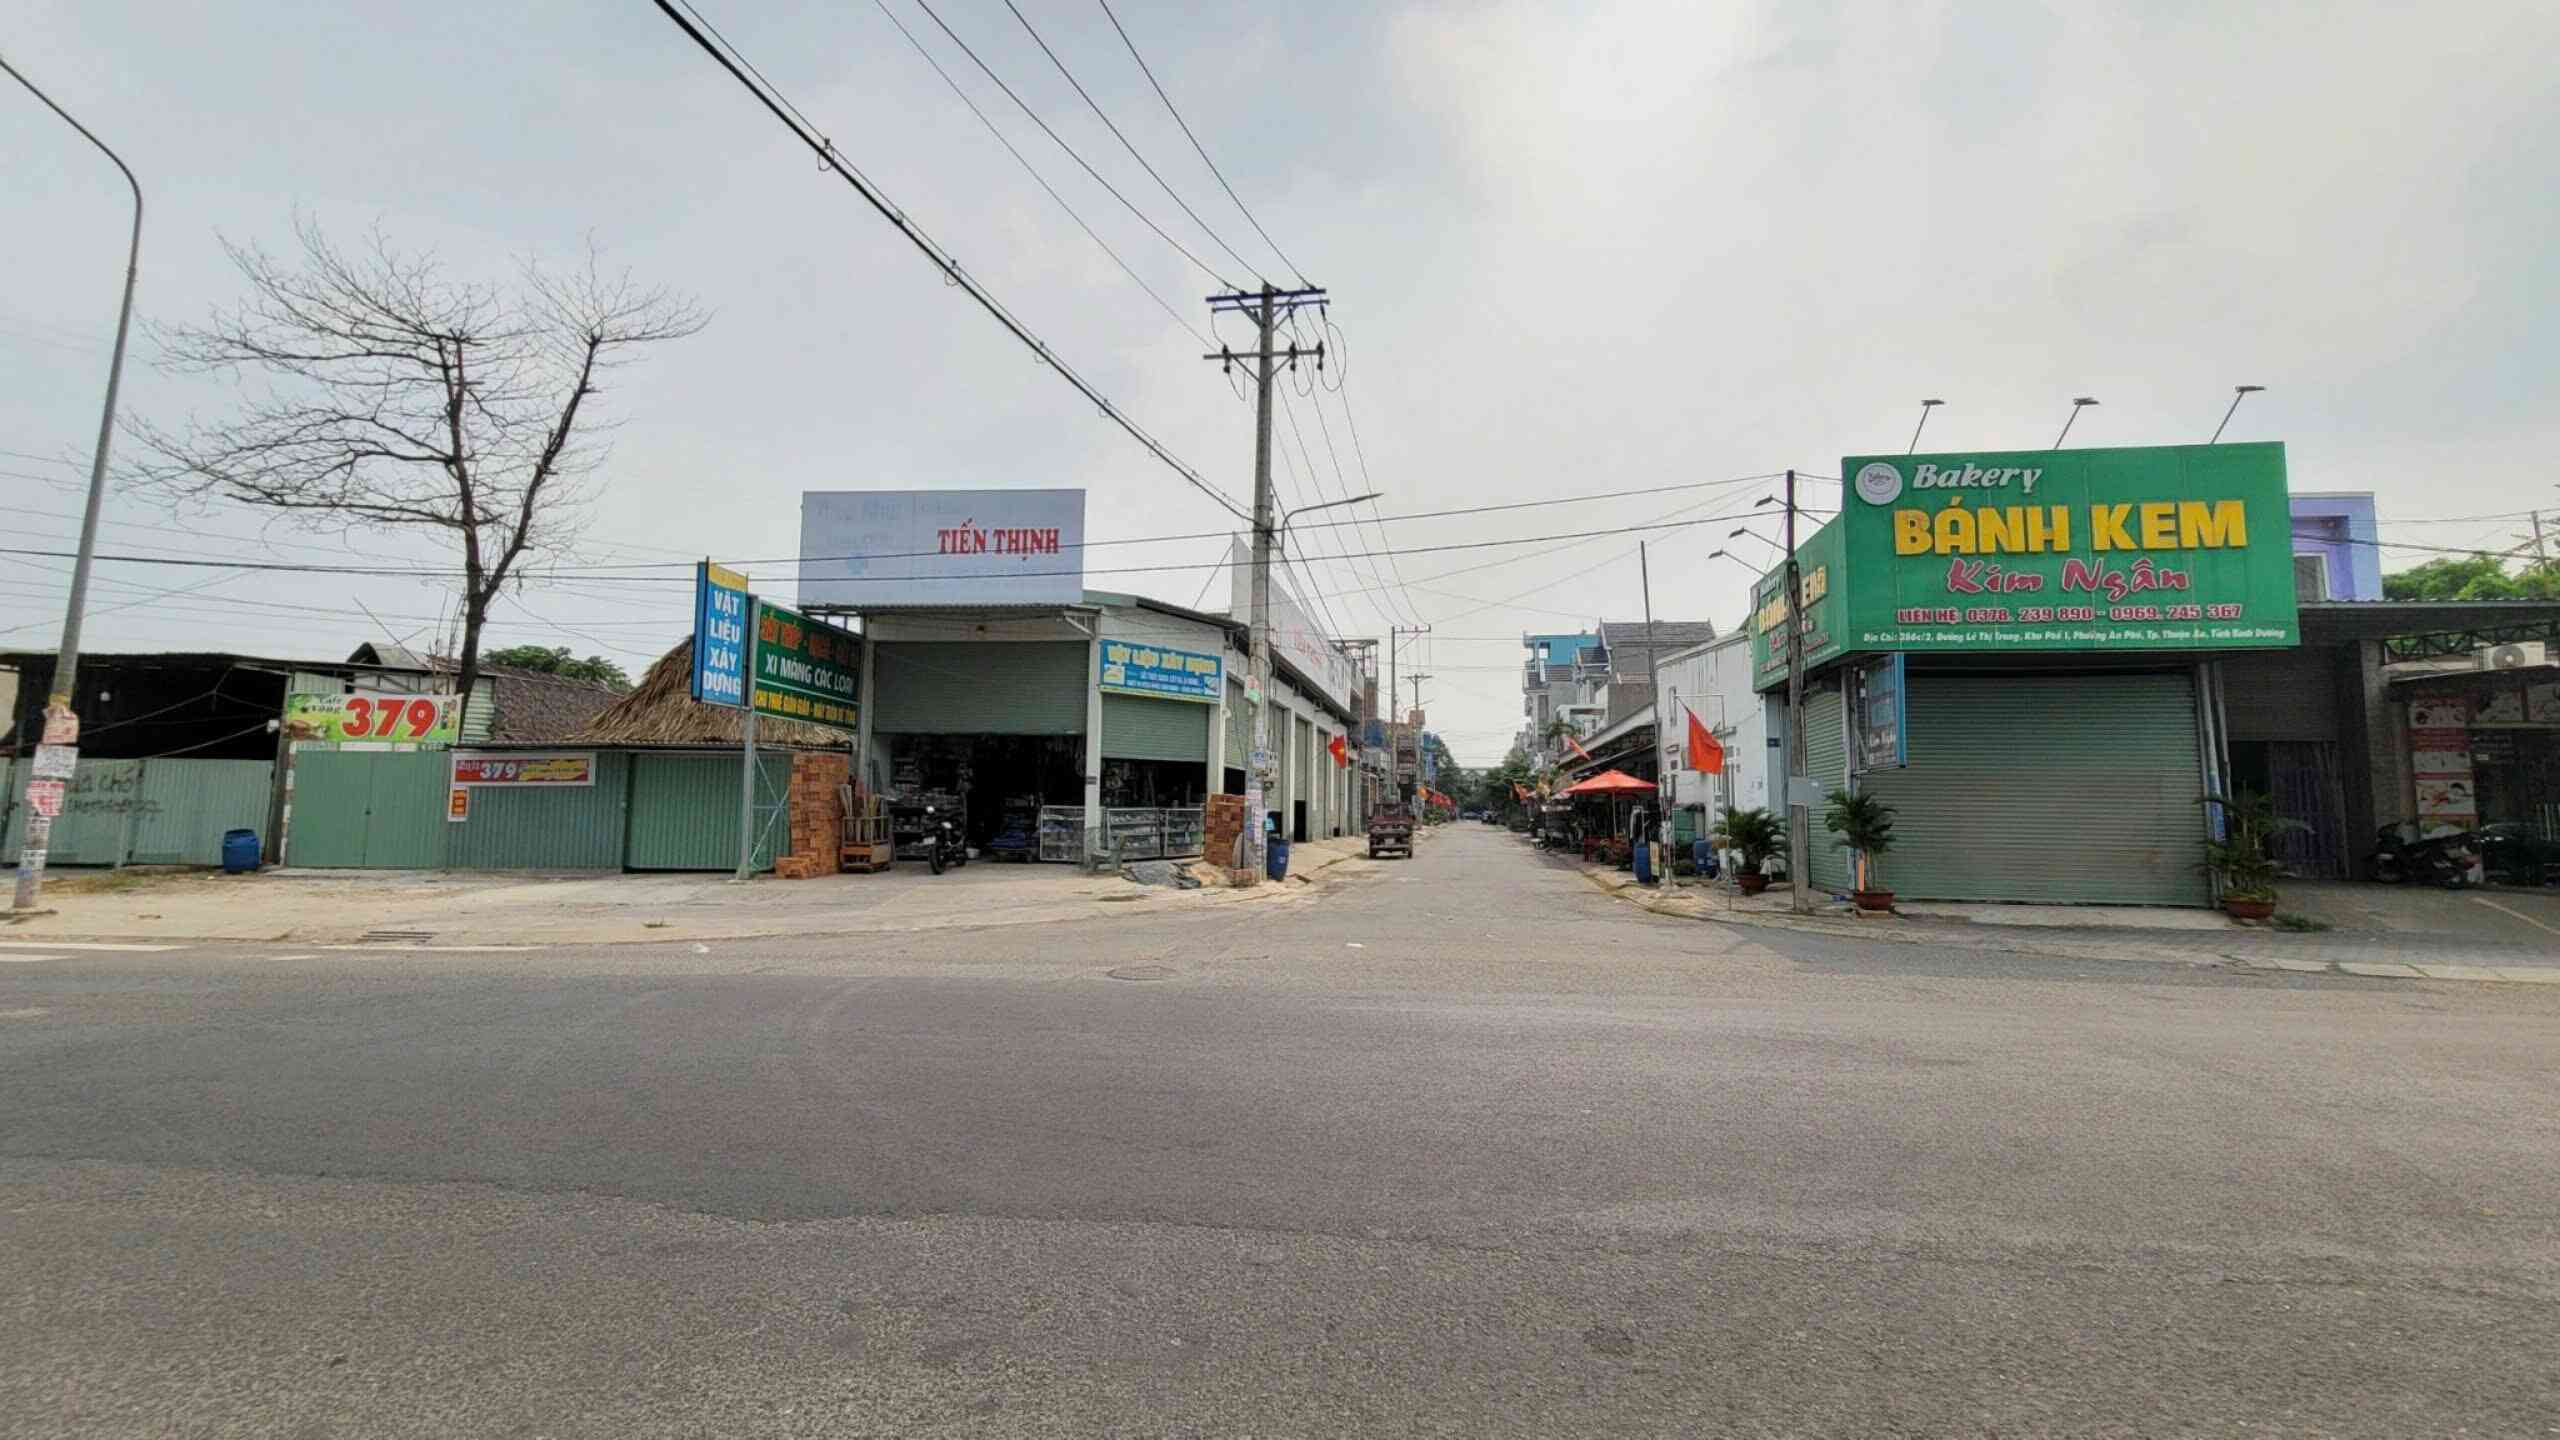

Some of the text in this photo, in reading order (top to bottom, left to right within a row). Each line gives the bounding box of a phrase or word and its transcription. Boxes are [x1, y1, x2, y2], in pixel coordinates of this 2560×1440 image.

[1912, 463, 2042, 493] Bakery
[937, 517, 1060, 561] TIẾN THỊNH
[1894, 496, 2248, 555] BÁNH KEM
[1948, 557, 2189, 602] Kim Ngân
[714, 590, 740, 617] VẬT
[2018, 607, 2053, 621] 239
[2057, 606, 2095, 621] 890
[2166, 604, 2201, 619] 245
[2207, 603, 2243, 619] 367
[709, 617, 741, 645] LIỆU
[709, 646, 738, 672] XÂY
[765, 653, 778, 676] XI
[703, 670, 741, 697] DỰNG
[342, 697, 440, 738] 379
[480, 761, 517, 779] 379
